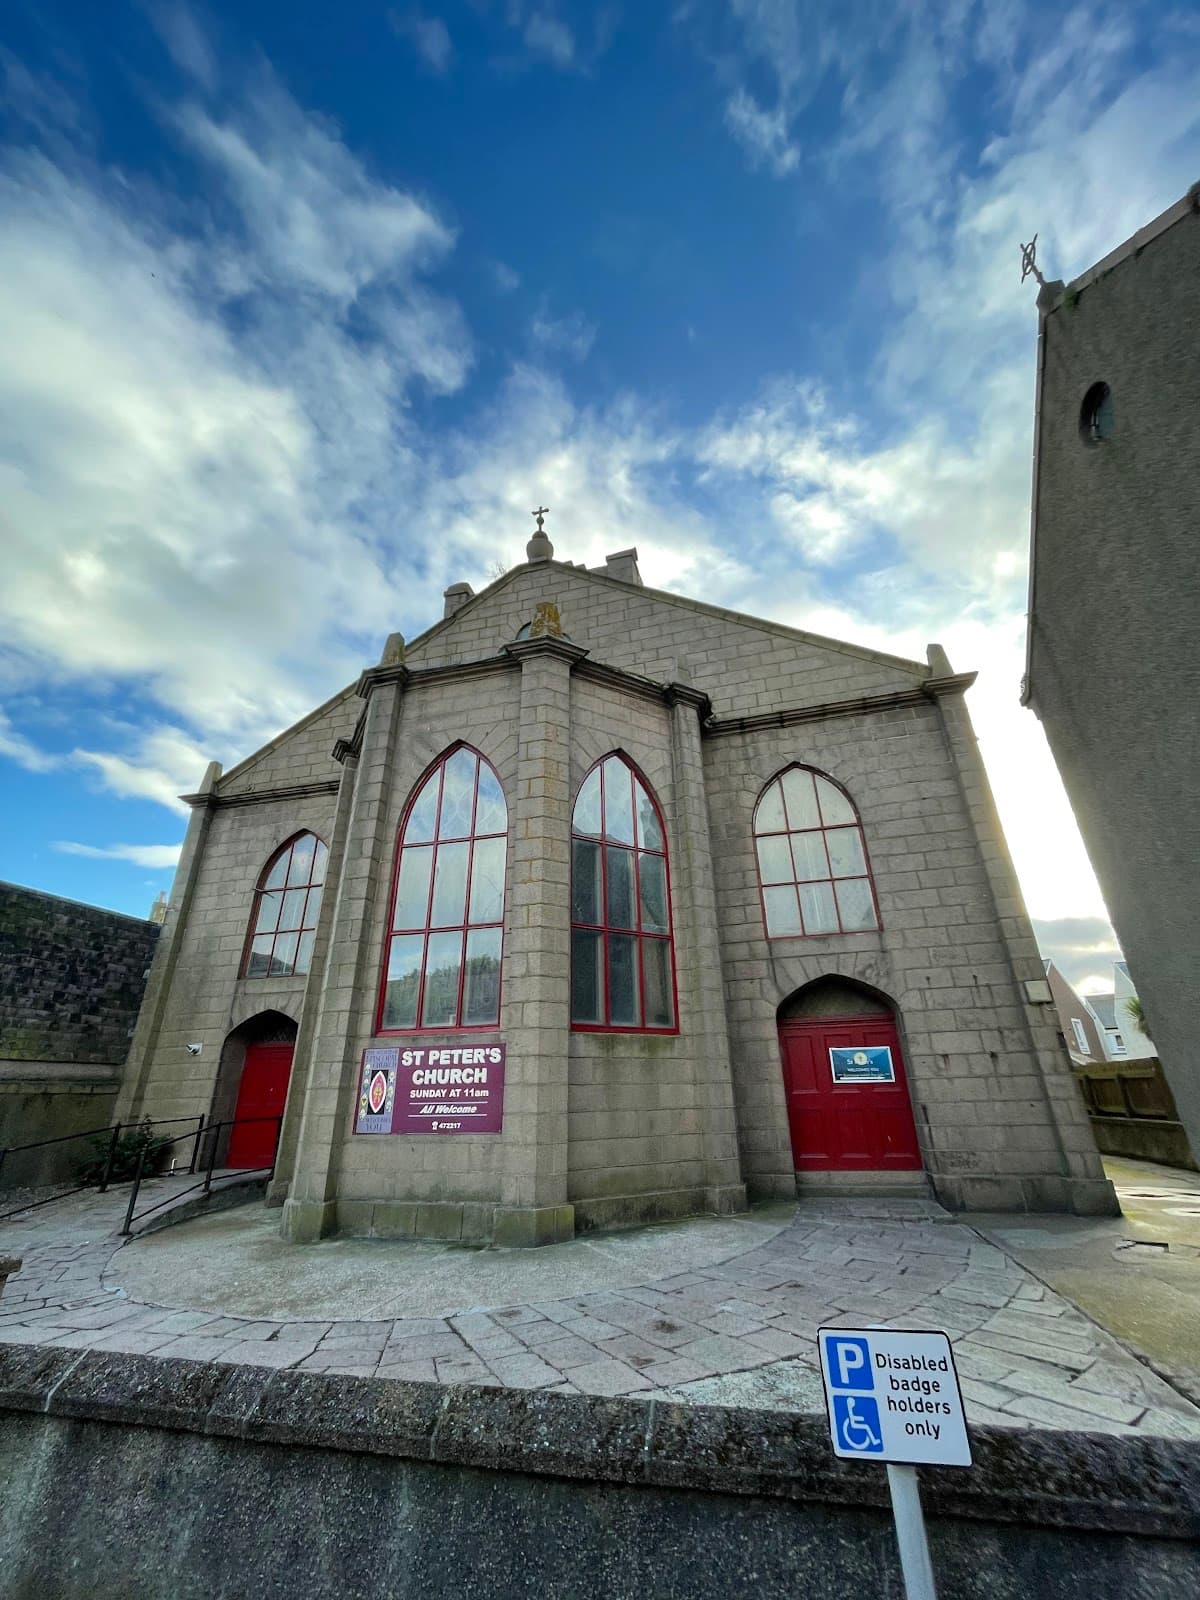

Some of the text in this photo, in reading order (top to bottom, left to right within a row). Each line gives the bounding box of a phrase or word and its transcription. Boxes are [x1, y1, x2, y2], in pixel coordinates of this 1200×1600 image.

[401, 1047, 502, 1066] ST PETER'S
[412, 1068, 488, 1085] CHURCH
[409, 1088, 489, 1098] SUNDAY AT 11am
[419, 1104, 477, 1114] All Welcome
[836, 1342, 864, 1384] P
[875, 1353, 949, 1372] Disabled
[889, 1375, 940, 1395] badge
[887, 1395, 951, 1415] holders
[905, 1419, 940, 1440] only
